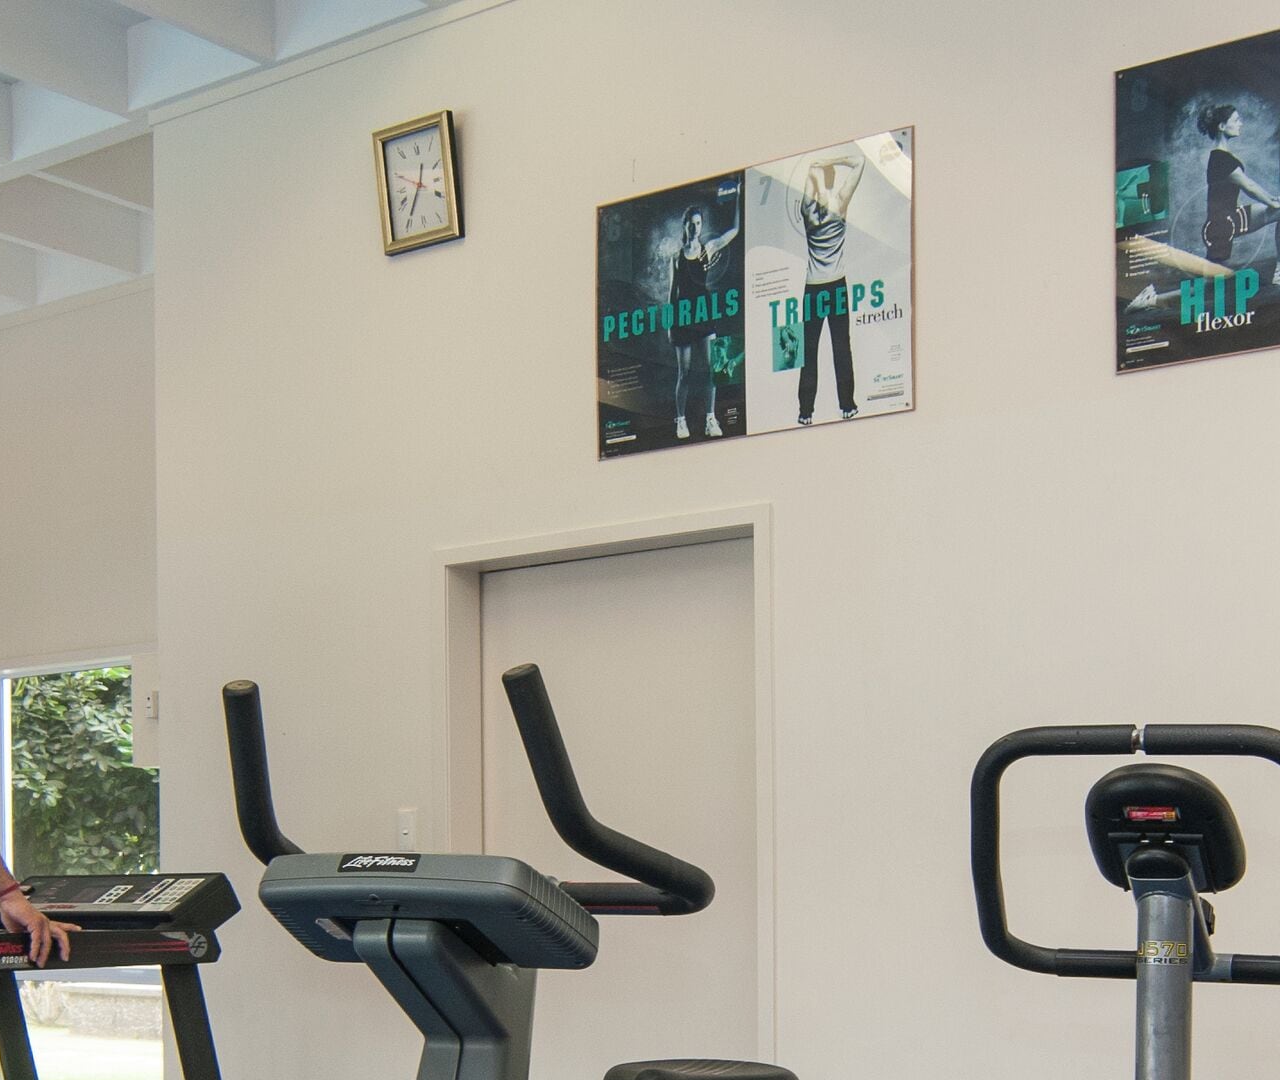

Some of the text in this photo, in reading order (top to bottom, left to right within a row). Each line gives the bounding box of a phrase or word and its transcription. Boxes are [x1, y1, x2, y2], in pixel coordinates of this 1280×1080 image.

[760, 175, 773, 206] 7
[603, 288, 740, 342] PECTORALS
[768, 279, 885, 328] TRICEPS
[855, 303, 904, 326] stretch
[1180, 267, 1260, 326] HIP
[1195, 310, 1256, 333] flexor
